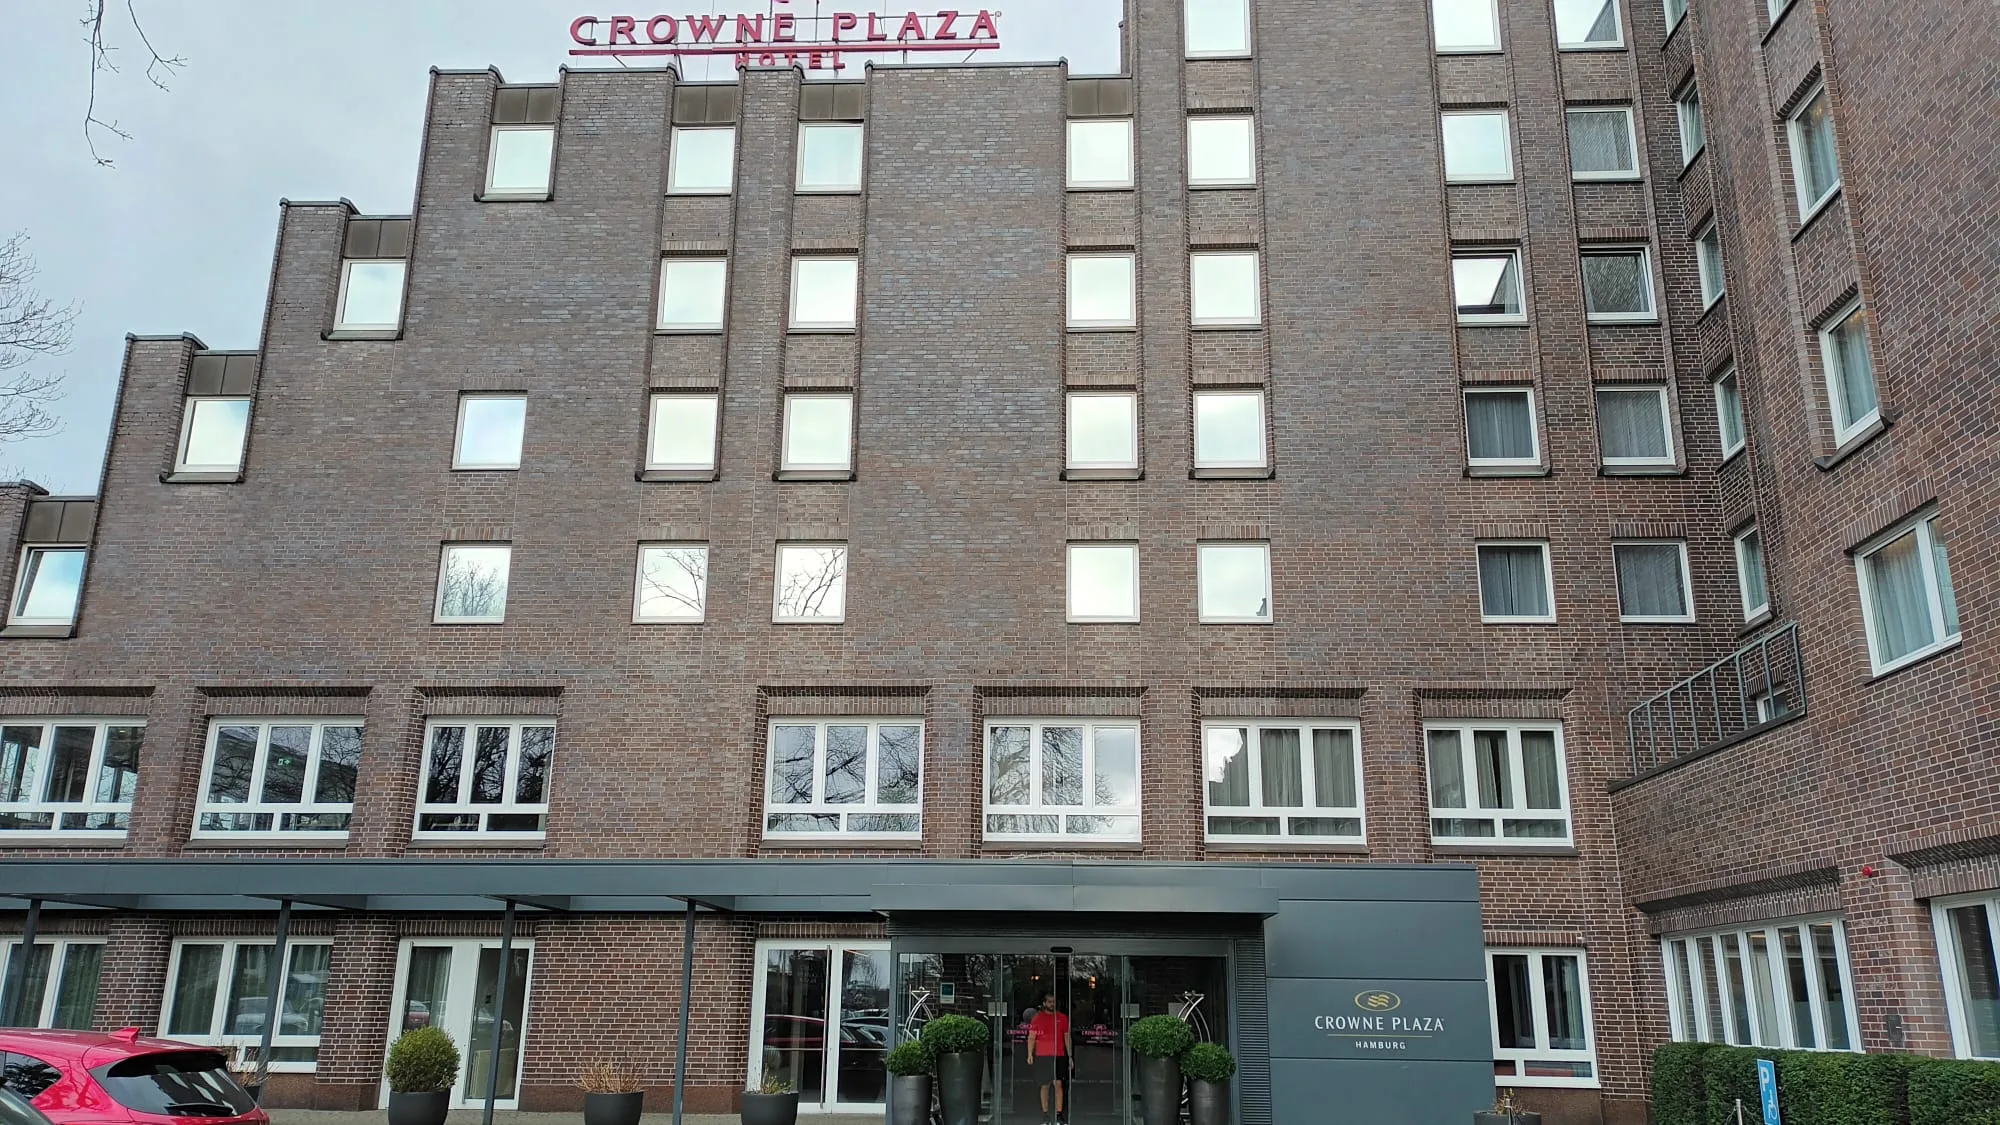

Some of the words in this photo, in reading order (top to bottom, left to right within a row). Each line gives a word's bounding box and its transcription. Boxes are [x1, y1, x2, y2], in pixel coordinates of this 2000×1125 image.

[569, 13, 796, 46] CROWNE
[832, 10, 998, 41] PLAZA
[735, 51, 846, 70] HOTEL
[1314, 1015, 1385, 1031] CROWNE
[1392, 1016, 1444, 1032] PLAZA
[1355, 1041, 1406, 1050] HAMBURG
[1760, 1066, 1770, 1091] P
